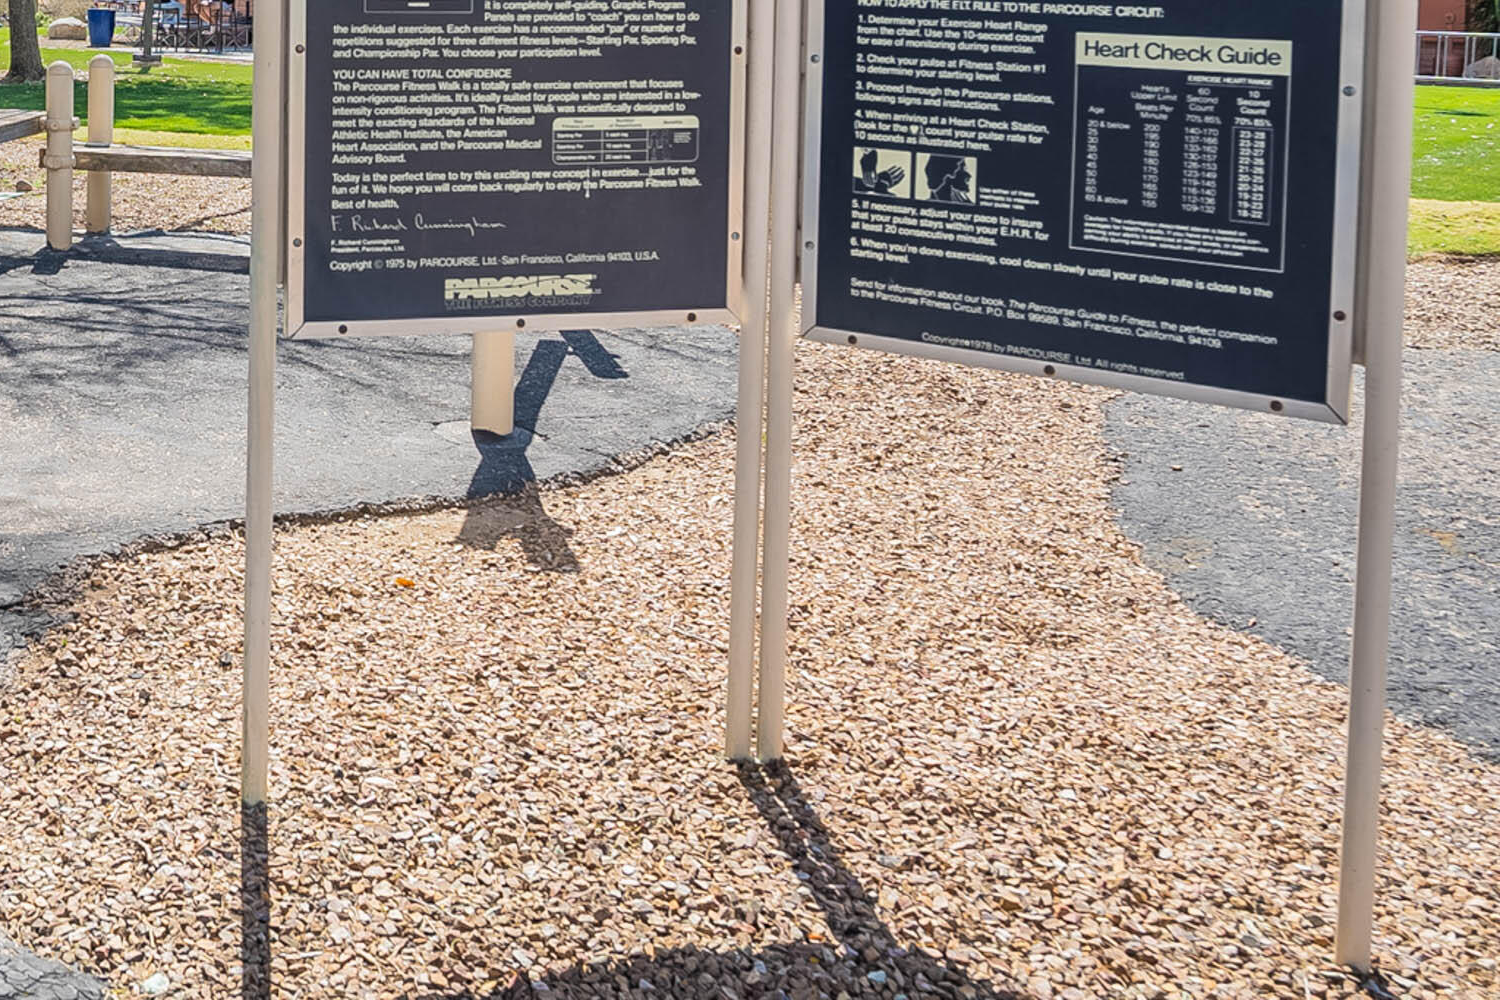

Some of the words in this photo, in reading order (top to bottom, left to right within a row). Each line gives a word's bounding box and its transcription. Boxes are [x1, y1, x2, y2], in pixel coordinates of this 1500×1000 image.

[972, 0, 1001, 12] RULE
[1001, 1, 1018, 13] TO
[1016, 1, 1041, 13] THE
[1042, 2, 1113, 16] PARCOURSE
[1114, 5, 1164, 18] CIRCUIT:
[1083, 39, 1140, 58] Heart
[1143, 41, 1212, 62] Check
[1216, 44, 1282, 66] Guide
[332, 68, 355, 79] YOU
[356, 68, 380, 79] CAN
[381, 68, 410, 79] HAVE
[410, 68, 444, 79] TOTAL
[444, 67, 512, 79] CONFIDENCE
[330, 199, 354, 209] Best
[354, 198, 366, 209] of
[328, 259, 372, 272] Copyright
[406, 258, 418, 269] by
[520, 253, 564, 264] Francisco,
[564, 252, 606, 263] California
[444, 273, 593, 300] PARCOURSE
